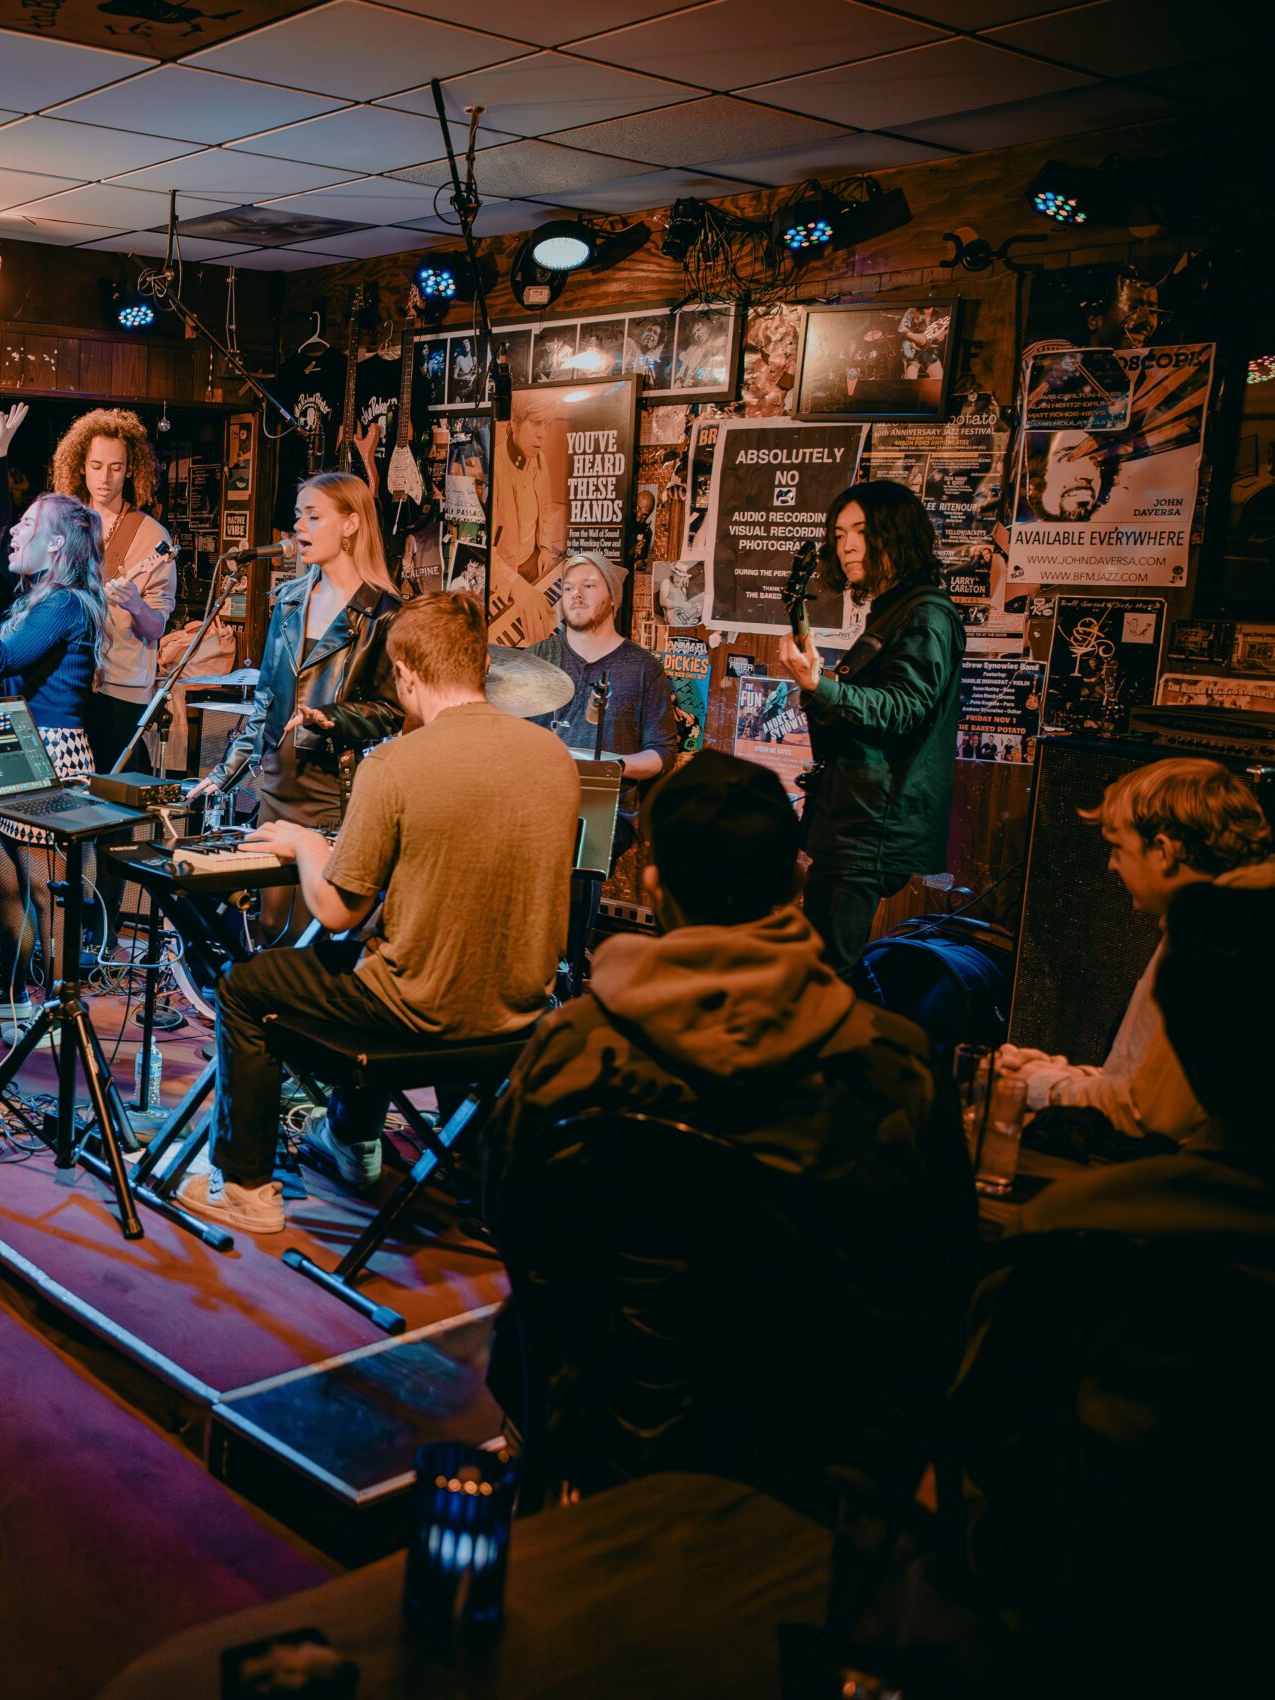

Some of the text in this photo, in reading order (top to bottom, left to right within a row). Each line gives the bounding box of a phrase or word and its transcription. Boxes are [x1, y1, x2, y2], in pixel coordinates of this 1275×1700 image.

[890, 428, 941, 436] ANNIVERSARY
[960, 427, 996, 435] FESTIVAL
[566, 430, 618, 454] YOU'VE
[736, 447, 845, 465] ABSOLUTELY
[573, 453, 625, 477] HEARD
[775, 470, 800, 486] NO
[568, 477, 617, 500] THESE
[939, 503, 978, 512] RITENOUR
[1153, 498, 1183, 507] JOHN
[570, 500, 623, 523] HANDS
[1133, 508, 1182, 517] DAVERSA
[227, 515, 246, 525] NATIVE
[732, 511, 827, 524] AUDIO RECORDIN
[227, 525, 245, 536] VIBE
[569, 529, 580, 538] From
[605, 528, 620, 538] Sound
[729, 525, 826, 538] VISUAL RECORDIN
[1015, 530, 1186, 547] AVAILABLE EVERYWHERE
[739, 539, 823, 552] PHOTOGRAY
[604, 548, 621, 557] Stories
[1026, 555, 1167, 567] WWW.JOHNDAVERSA.COM
[734, 568, 759, 577] DURING
[760, 569, 773, 577] THE
[1040, 571, 1149, 583] WWW.BFMJAZZ.COM
[950, 576, 975, 586] LARRY
[950, 584, 986, 594] CARLTON
[746, 591, 782, 600] THE BAKED
[983, 662, 1019, 671] Synowiec
[740, 690, 762, 708] FUN
[763, 708, 795, 734] ANDREW
[966, 714, 992, 723] FRIDAY
[770, 713, 808, 739] SYNOWIE
[997, 726, 1027, 735] POTATO
